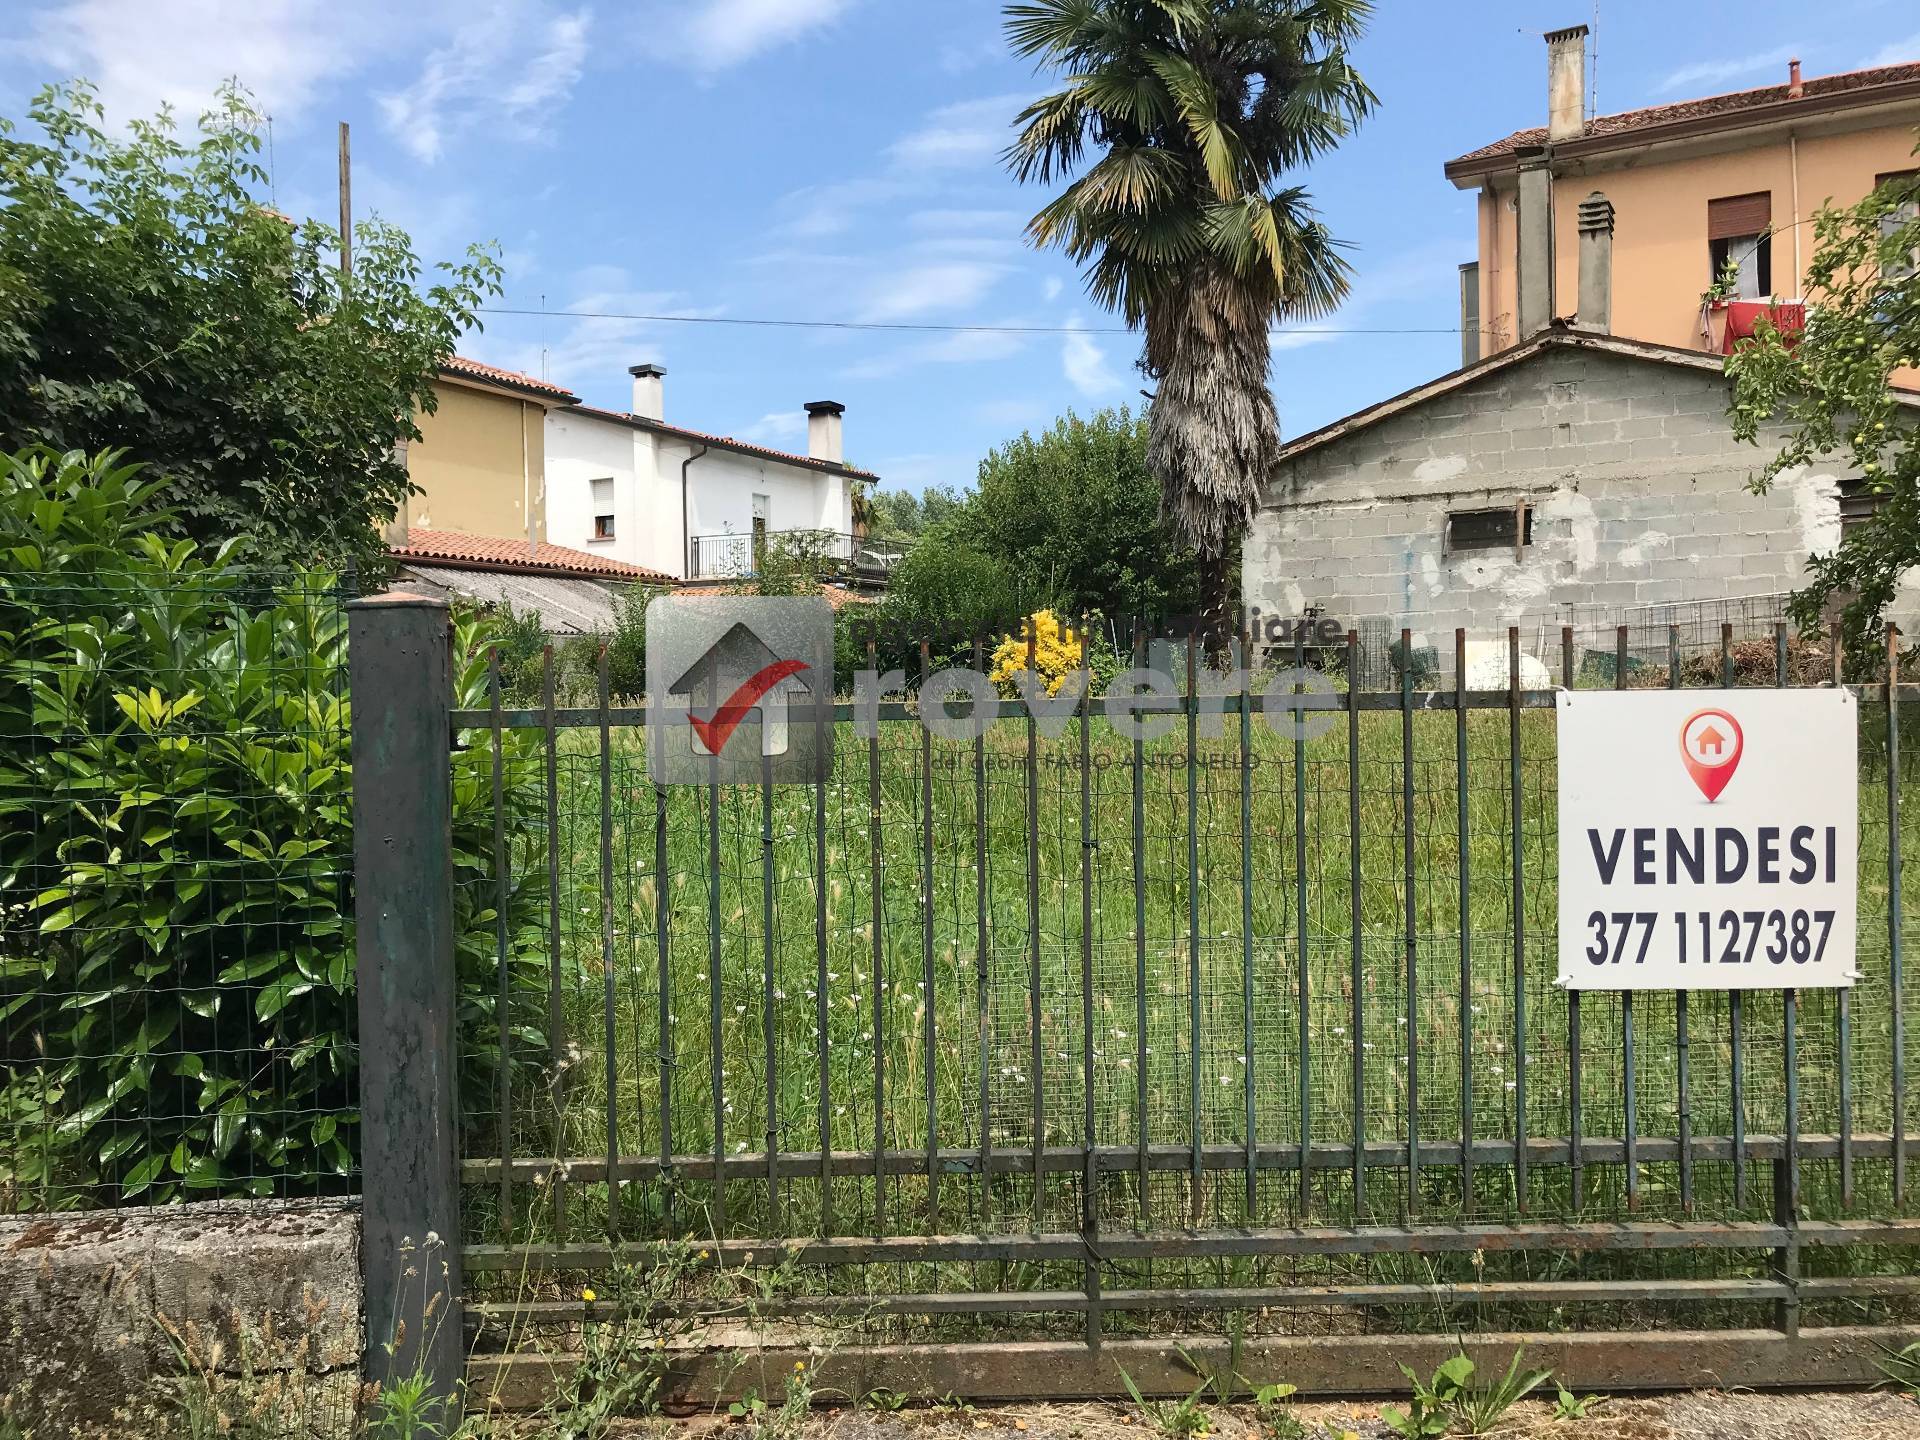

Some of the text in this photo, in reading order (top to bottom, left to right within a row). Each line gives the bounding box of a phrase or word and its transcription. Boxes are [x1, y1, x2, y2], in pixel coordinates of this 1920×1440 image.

[1586, 825, 1837, 885] VENDESI
[1585, 909, 1837, 966] 377 1127387
